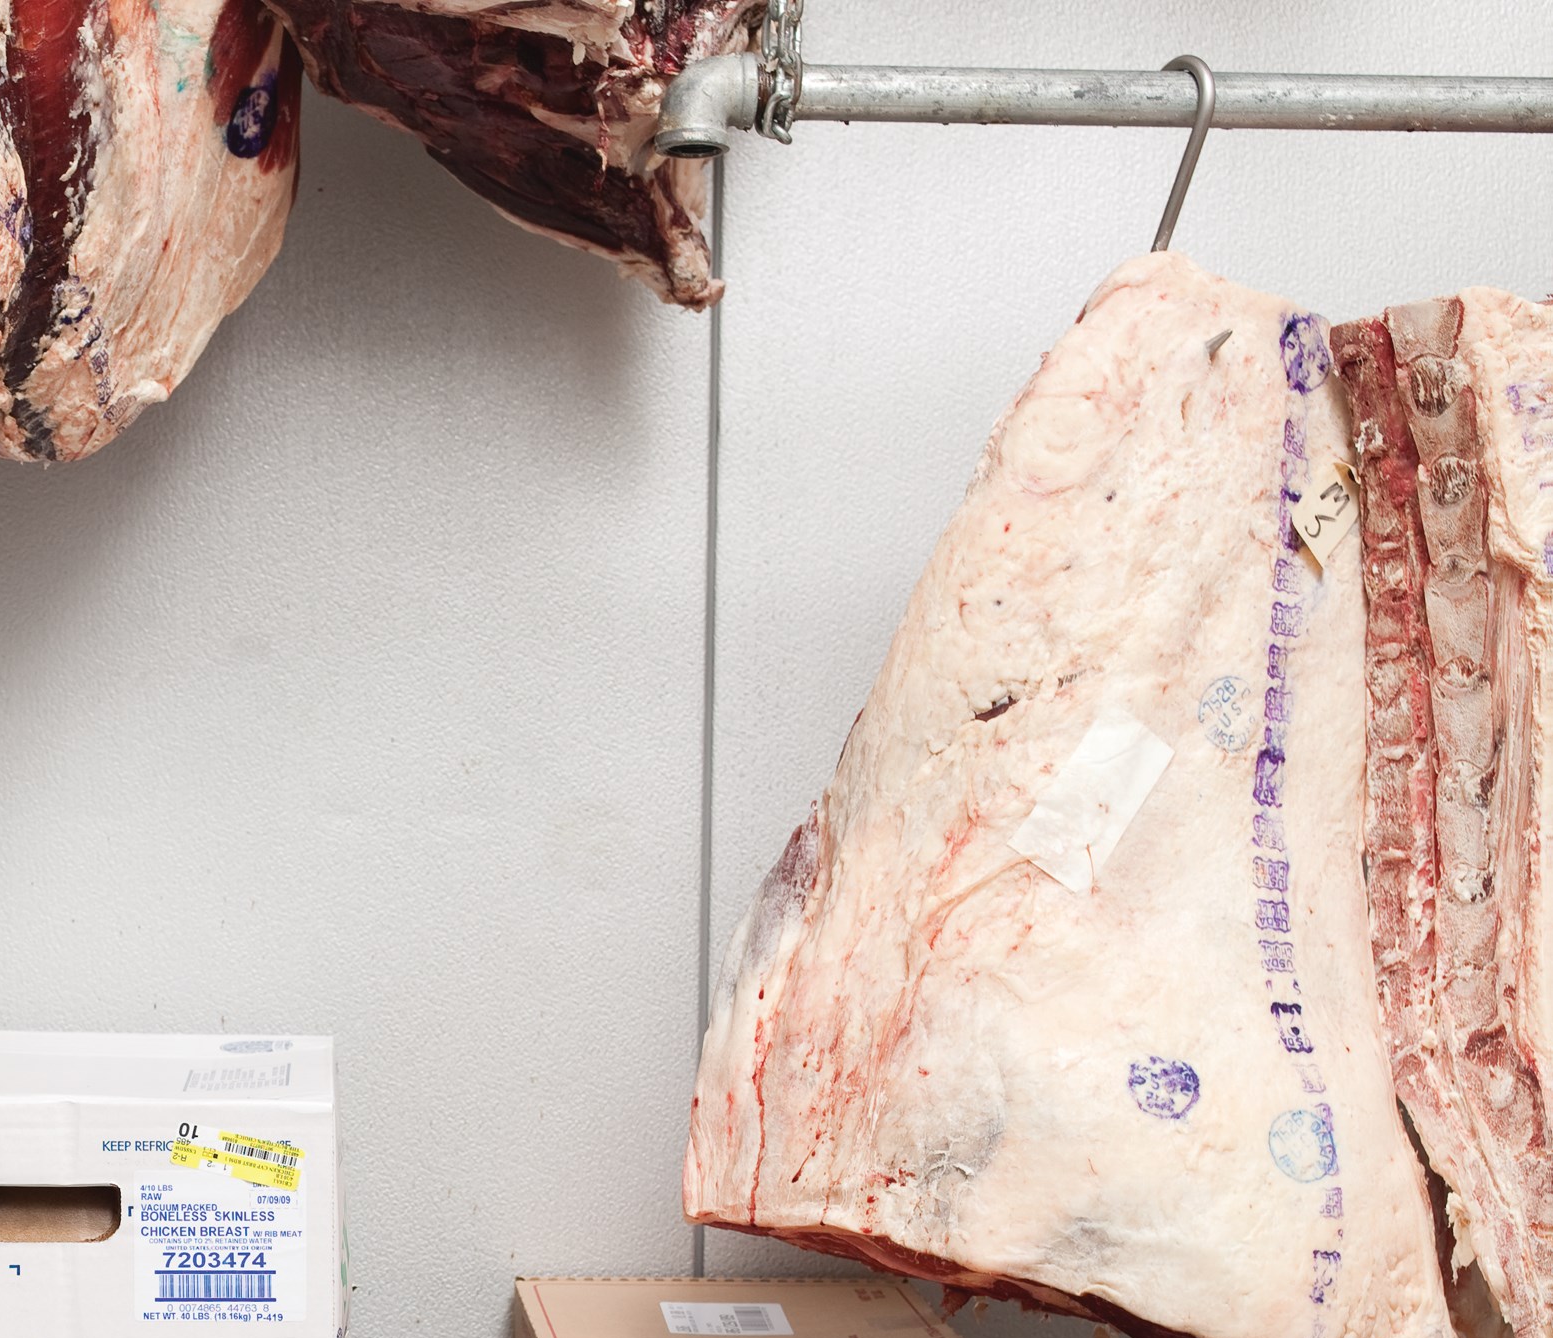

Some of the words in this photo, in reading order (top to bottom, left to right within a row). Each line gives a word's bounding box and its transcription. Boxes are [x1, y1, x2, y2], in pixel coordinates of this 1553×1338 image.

[178, 1122, 199, 1140] 10
[102, 1140, 132, 1152] KEEP
[140, 1184, 156, 1192] 4/10
[157, 1184, 173, 1192] LBS
[141, 1193, 162, 1201] RAW
[257, 1195, 291, 1205] 07/09/09
[140, 1204, 179, 1212] VACUUM
[181, 1203, 218, 1211] PACKED
[140, 1211, 208, 1222] BONELESS
[214, 1210, 275, 1222] SKINLESS
[140, 1226, 196, 1237] CHICKEN
[199, 1226, 250, 1237] BREAST
[265, 1230, 278, 1238] RIB
[280, 1230, 302, 1238] MEAT
[162, 1252, 267, 1268] 7203474
[179, 1304, 222, 1312] 0074865
[227, 1304, 258, 1312] 44763
[143, 1312, 161, 1320] NET
[162, 1312, 178, 1320] WT.
[180, 1312, 191, 1320] 40
[214, 1312, 252, 1322] (18.16kg)
[256, 1313, 284, 1321] P-419
